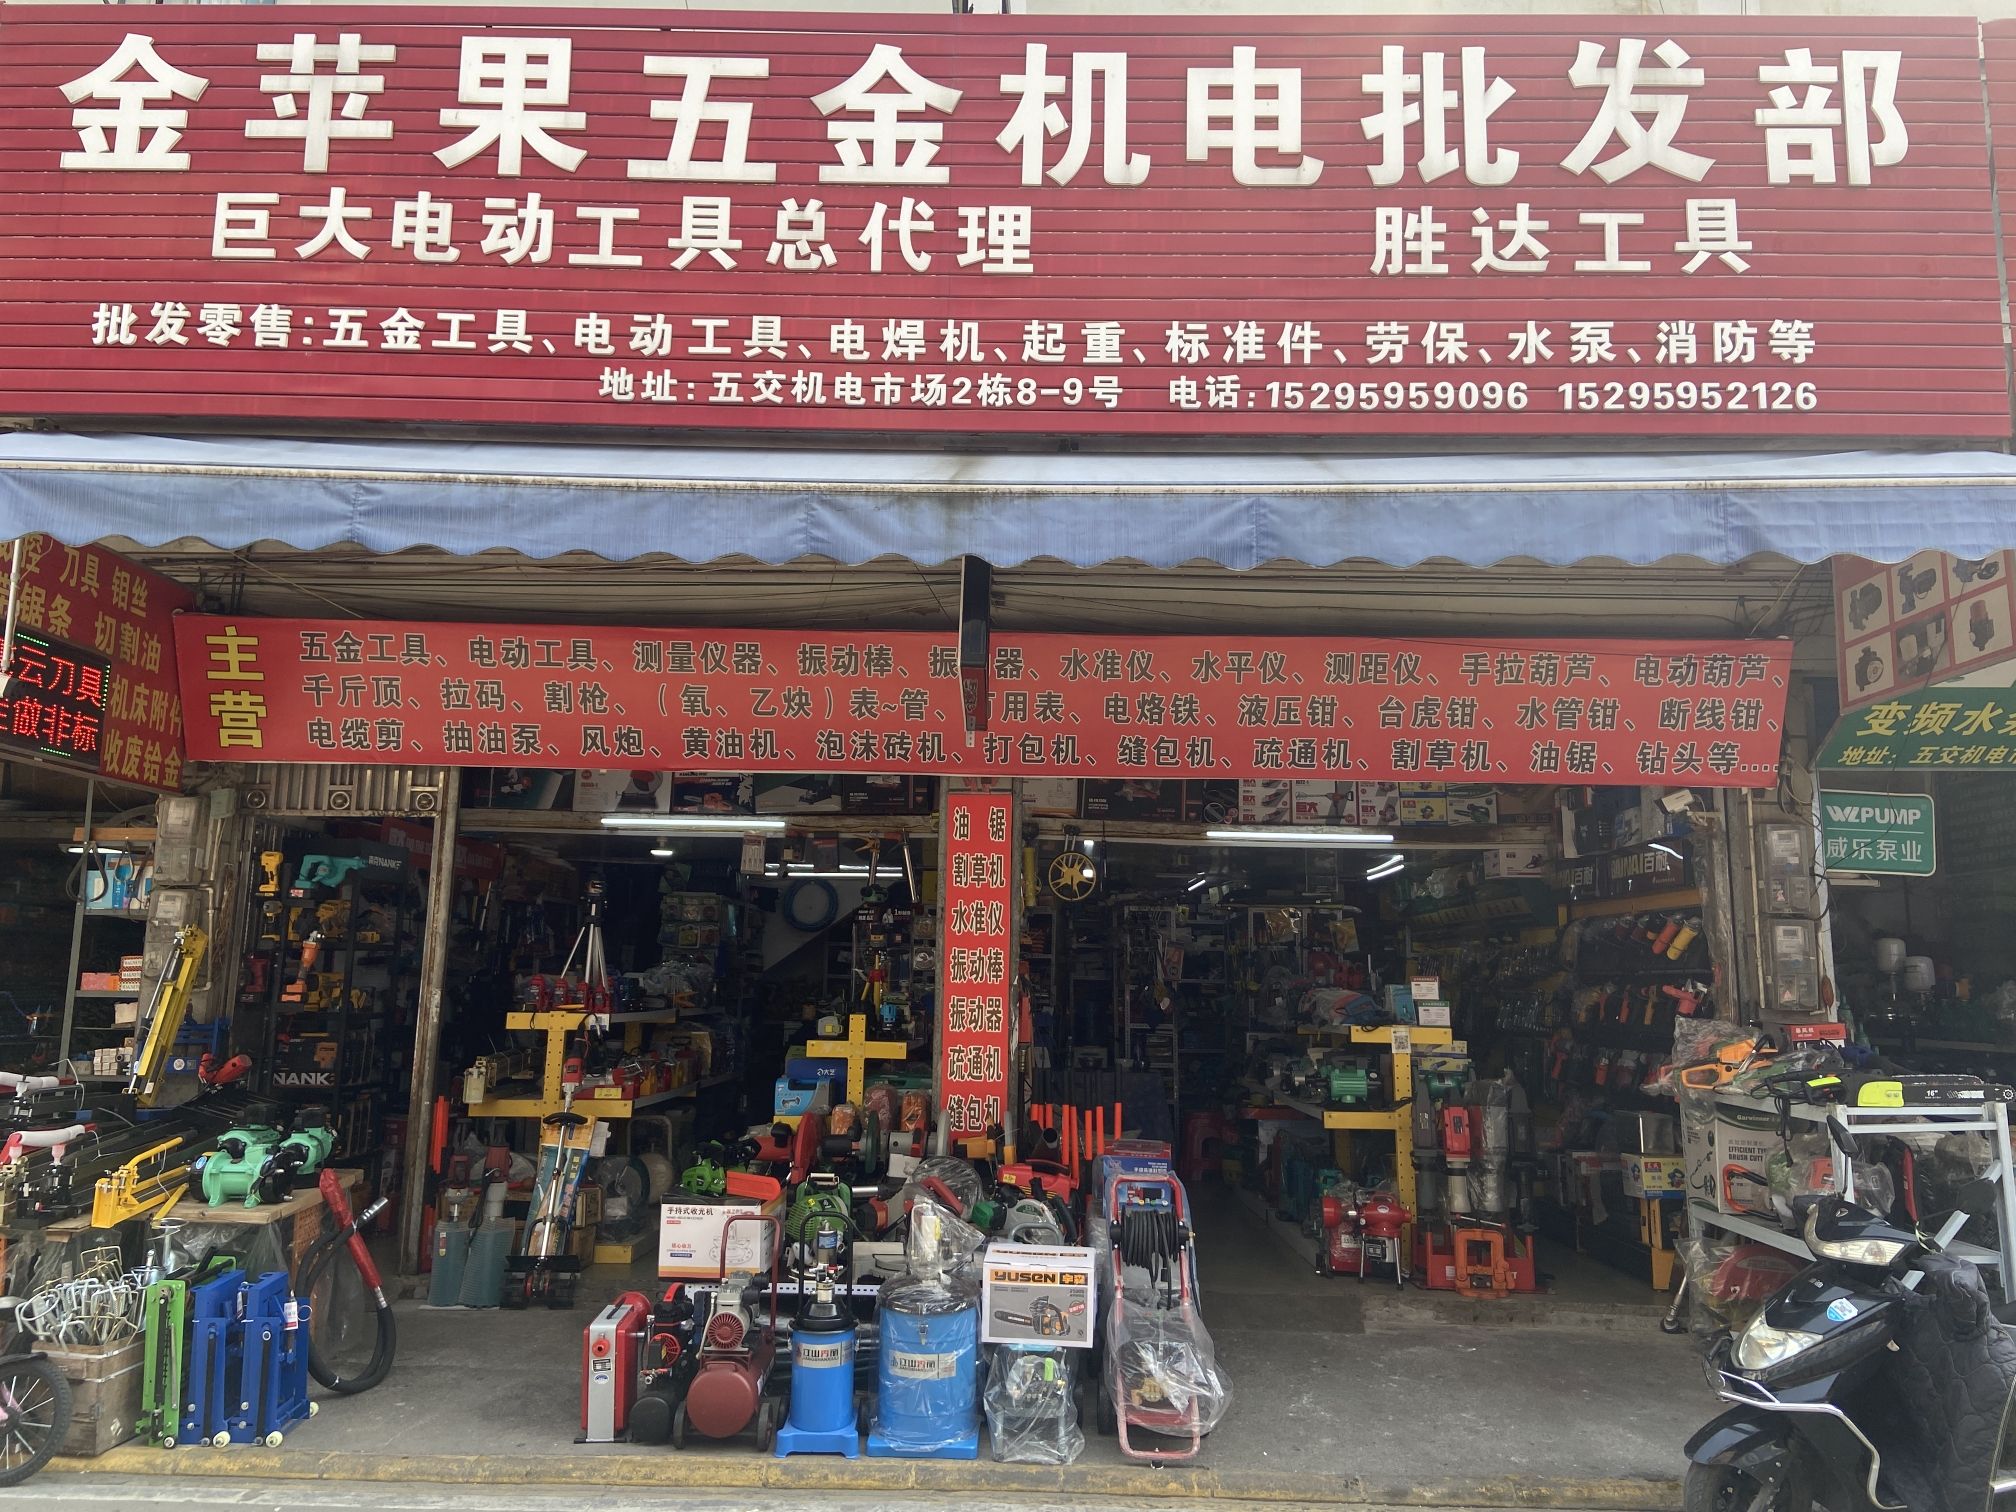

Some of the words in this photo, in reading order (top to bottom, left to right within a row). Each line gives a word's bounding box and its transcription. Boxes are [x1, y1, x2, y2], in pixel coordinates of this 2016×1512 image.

[59, 32, 1909, 187] 金苹果五金机电批发部
[211, 187, 1034, 274] 巨大电动工具总代理
[1370, 198, 1753, 275] 胜达工具
[1557, 381, 1818, 411] 15295952126
[59, 547, 100, 598] 刀具
[112, 565, 148, 618] 钼丝
[94, 611, 162, 674] 切割油
[206, 626, 267, 748] 主营
[1837, 745, 2016, 766] 地址：五交机电
[1826, 836, 1922, 862] 威乐泵业
[952, 853, 1005, 887] 割草机
[951, 900, 1004, 935] 水准仪
[950, 948, 1004, 984] 振动棒
[949, 996, 1003, 1032] 振动器
[948, 1046, 1002, 1081] 疏通机
